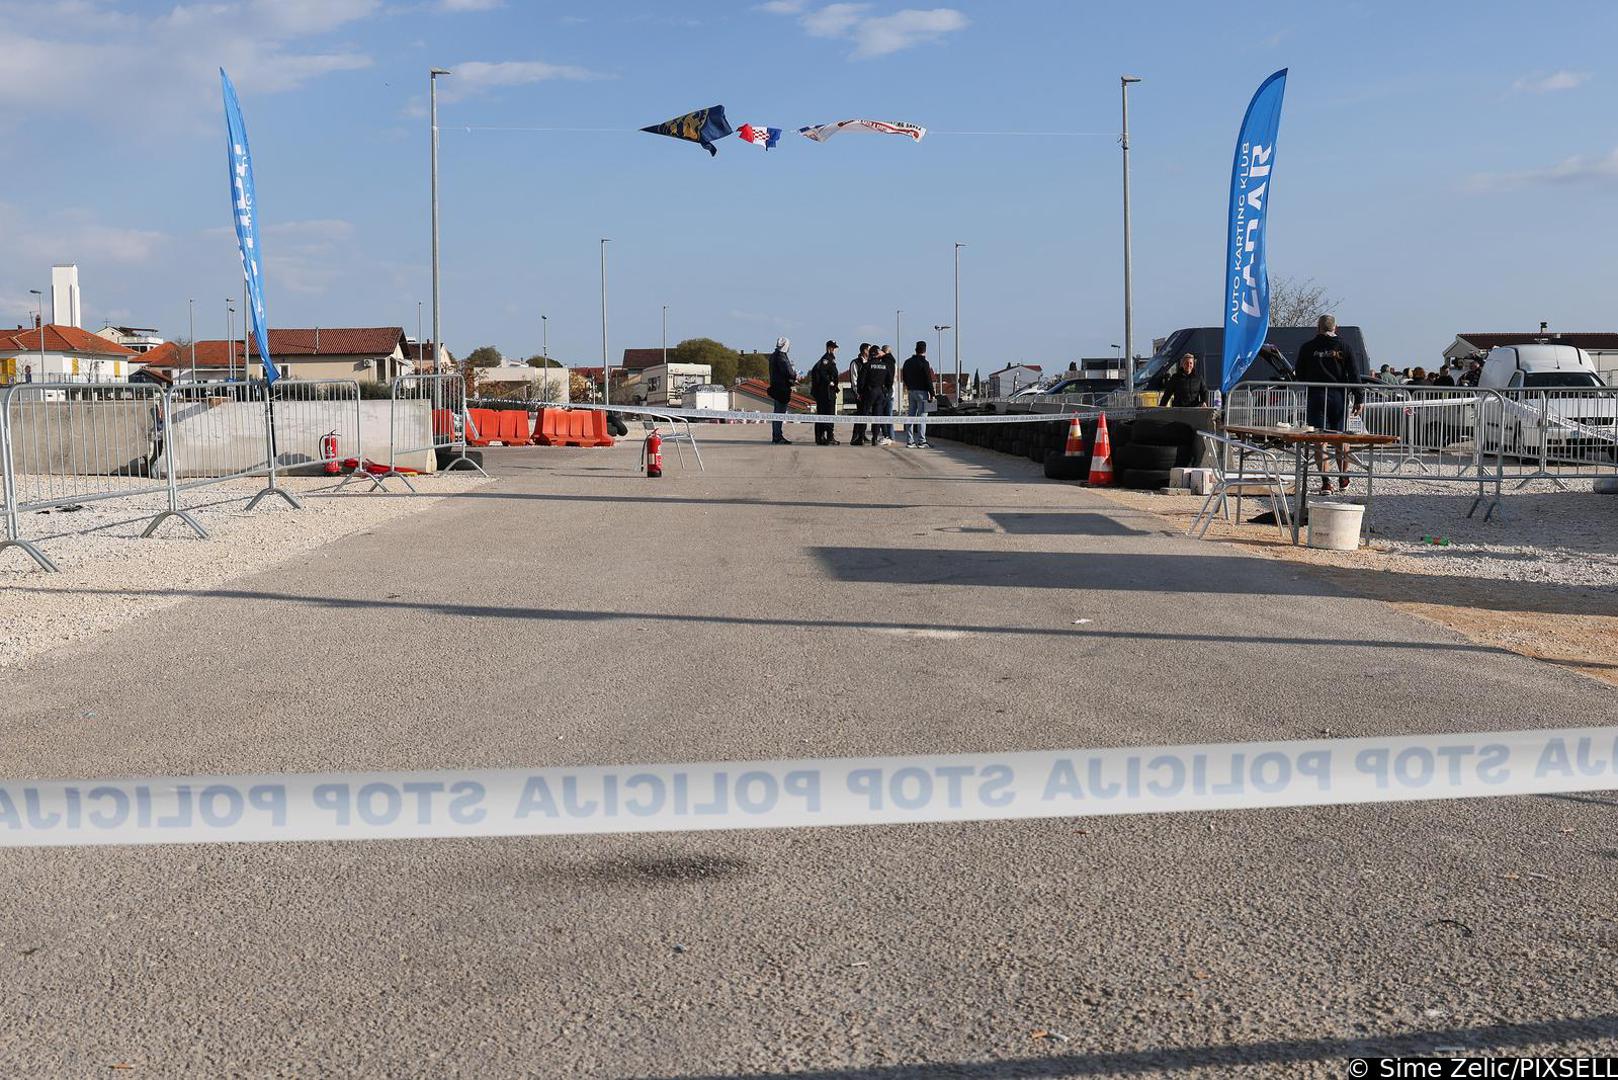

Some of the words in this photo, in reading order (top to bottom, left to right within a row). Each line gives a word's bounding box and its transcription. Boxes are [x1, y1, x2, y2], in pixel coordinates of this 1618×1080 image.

[1240, 142, 1250, 188] KLUB
[1235, 195, 1246, 270] KARTING
[1230, 276, 1241, 324] AUTO
